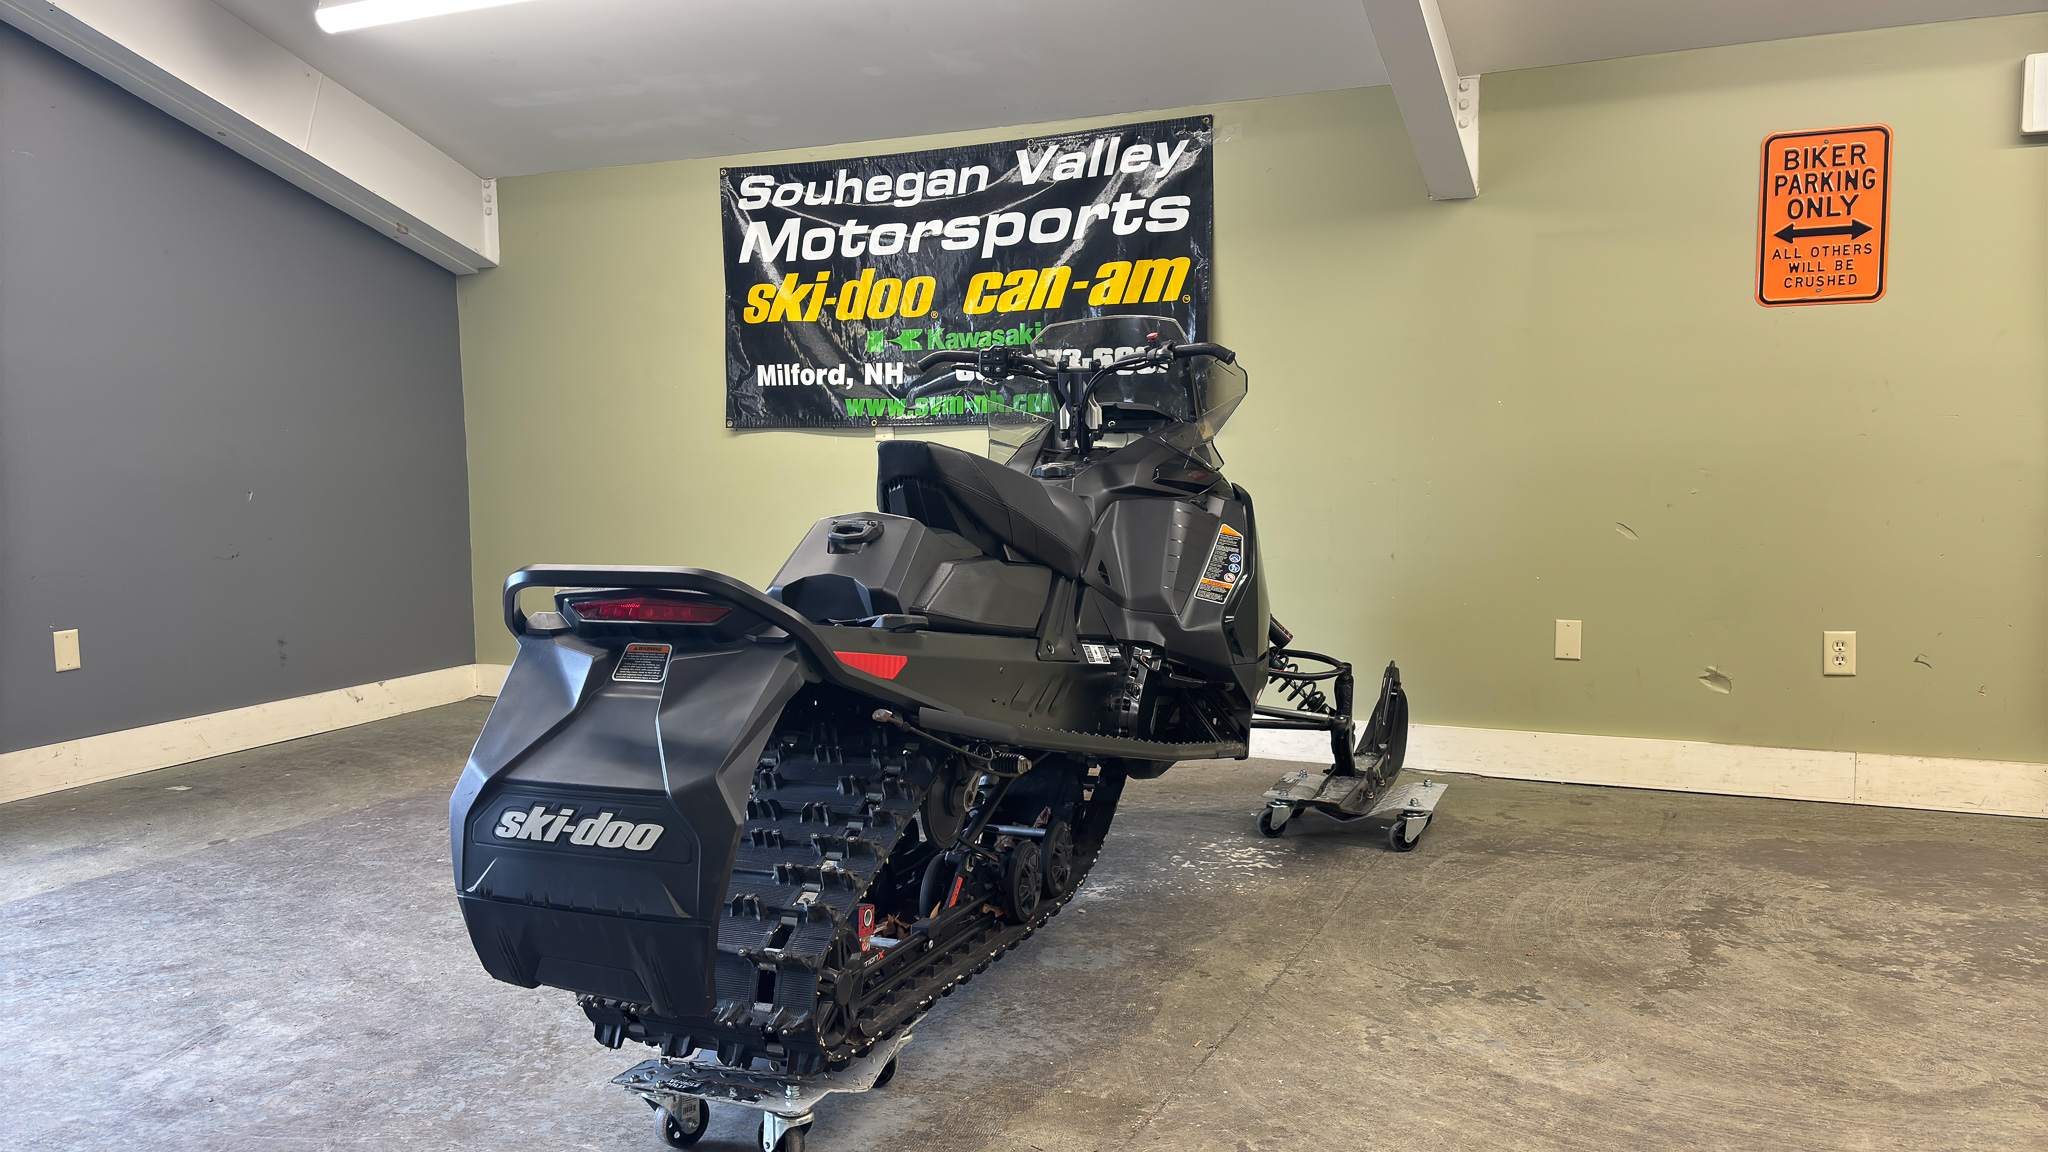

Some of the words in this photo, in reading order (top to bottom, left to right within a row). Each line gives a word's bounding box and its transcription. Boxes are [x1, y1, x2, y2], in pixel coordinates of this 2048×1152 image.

[1784, 143, 1867, 171] BIKER
[738, 164, 990, 210] Souhegan
[1016, 136, 1190, 186] Valley
[1774, 168, 1877, 196] PARKING
[1787, 193, 1860, 219] ONLY
[738, 192, 1191, 264] Motorsports
[1772, 247, 1802, 260] ALL
[1811, 243, 1873, 258] OTHERS
[1789, 261, 1826, 273] WILL
[1835, 259, 1854, 271] BE
[743, 268, 936, 324] ski-doo
[963, 257, 1191, 315] can-am
[1784, 274, 1858, 288] CRUSHED
[927, 321, 1043, 350] Kawasaki
[756, 363, 854, 390] Milford,
[864, 362, 904, 386] NH
[495, 806, 665, 851] ski-doo
